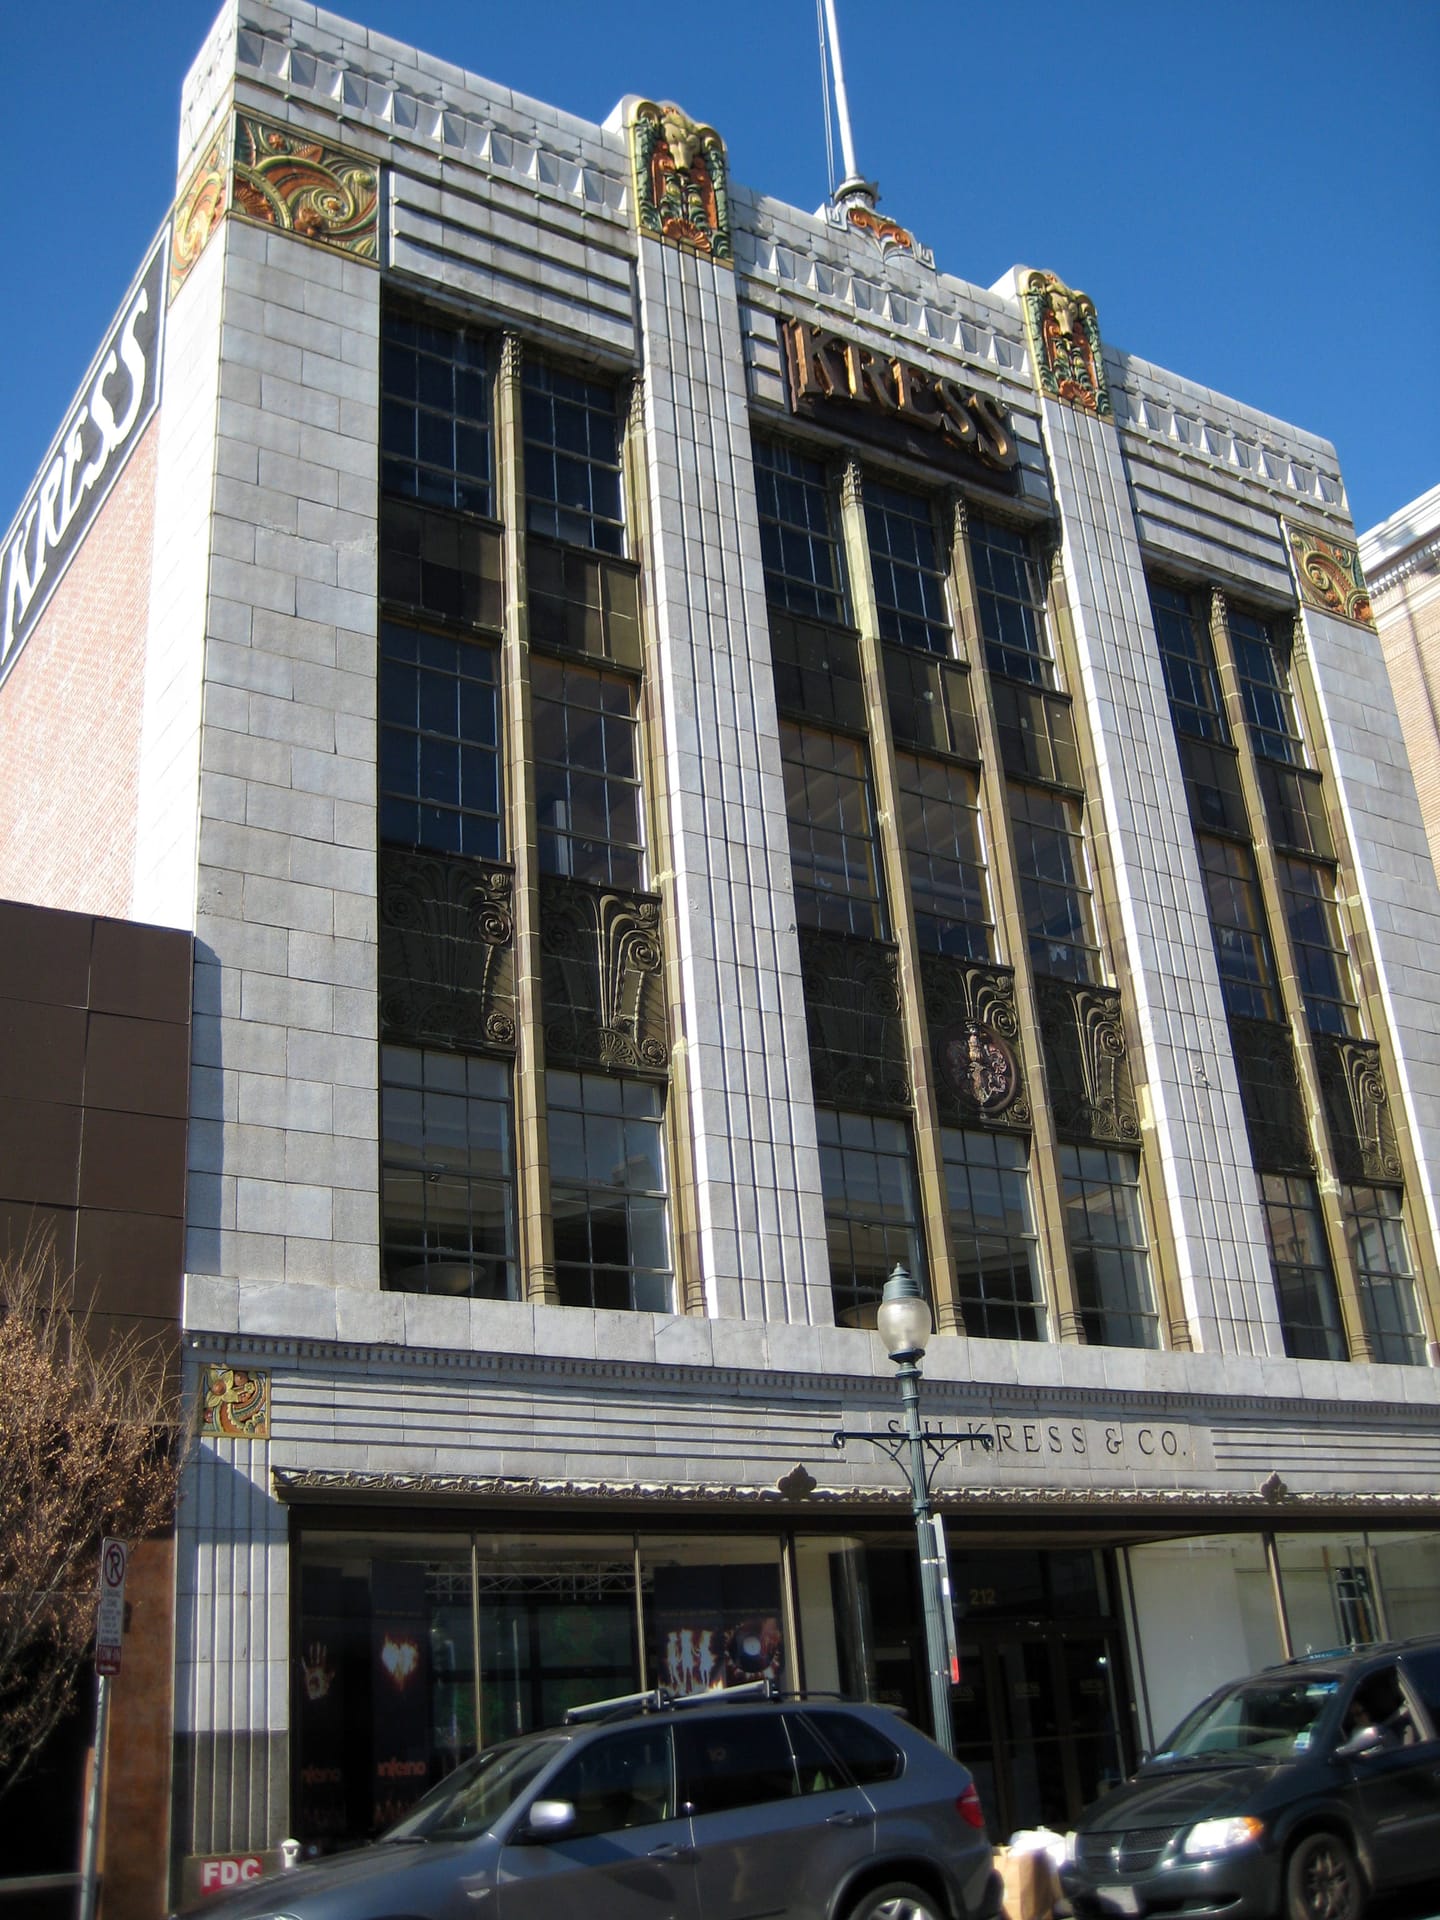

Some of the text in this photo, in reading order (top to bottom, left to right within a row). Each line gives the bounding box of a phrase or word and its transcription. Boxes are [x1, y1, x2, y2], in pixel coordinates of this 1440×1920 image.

[789, 318, 1017, 467] KRESS
[1, 287, 148, 667] KRESS
[967, 1422, 1086, 1454] KRESS
[1105, 1428, 1122, 1454] &
[1138, 1429, 1187, 1456] CO.
[969, 1588, 996, 1605] 212
[203, 1859, 259, 1887] FDC
